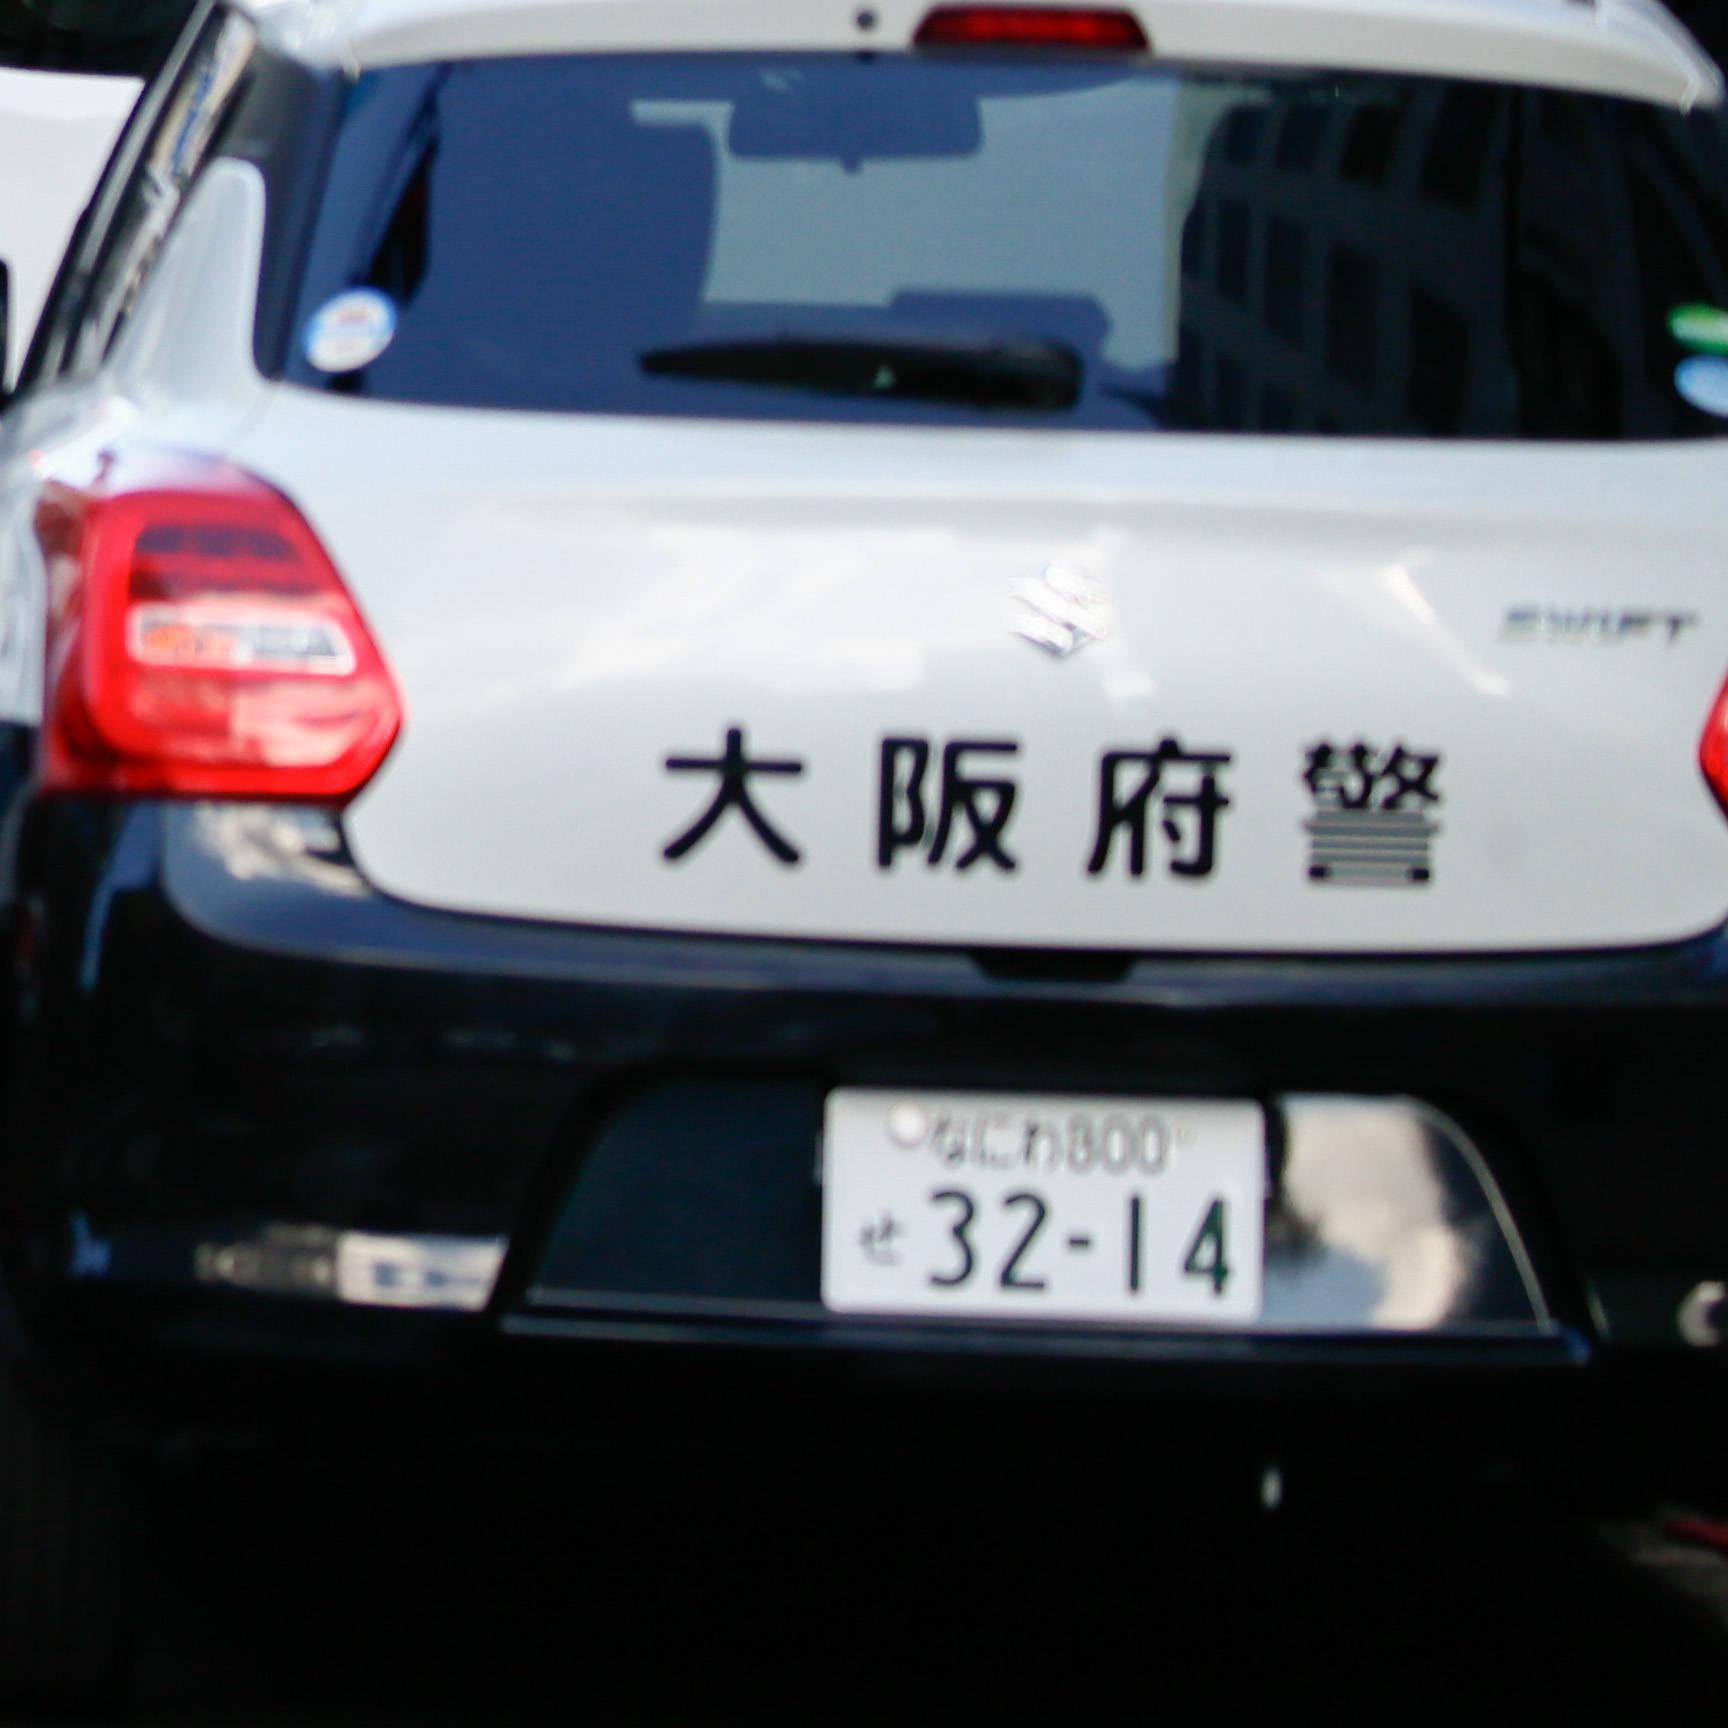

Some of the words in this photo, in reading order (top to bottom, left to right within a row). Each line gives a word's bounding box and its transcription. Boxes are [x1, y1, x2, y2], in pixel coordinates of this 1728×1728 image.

[661, 726, 1444, 886] 大阪府警
[927, 1189, 1232, 1296] 32-14
